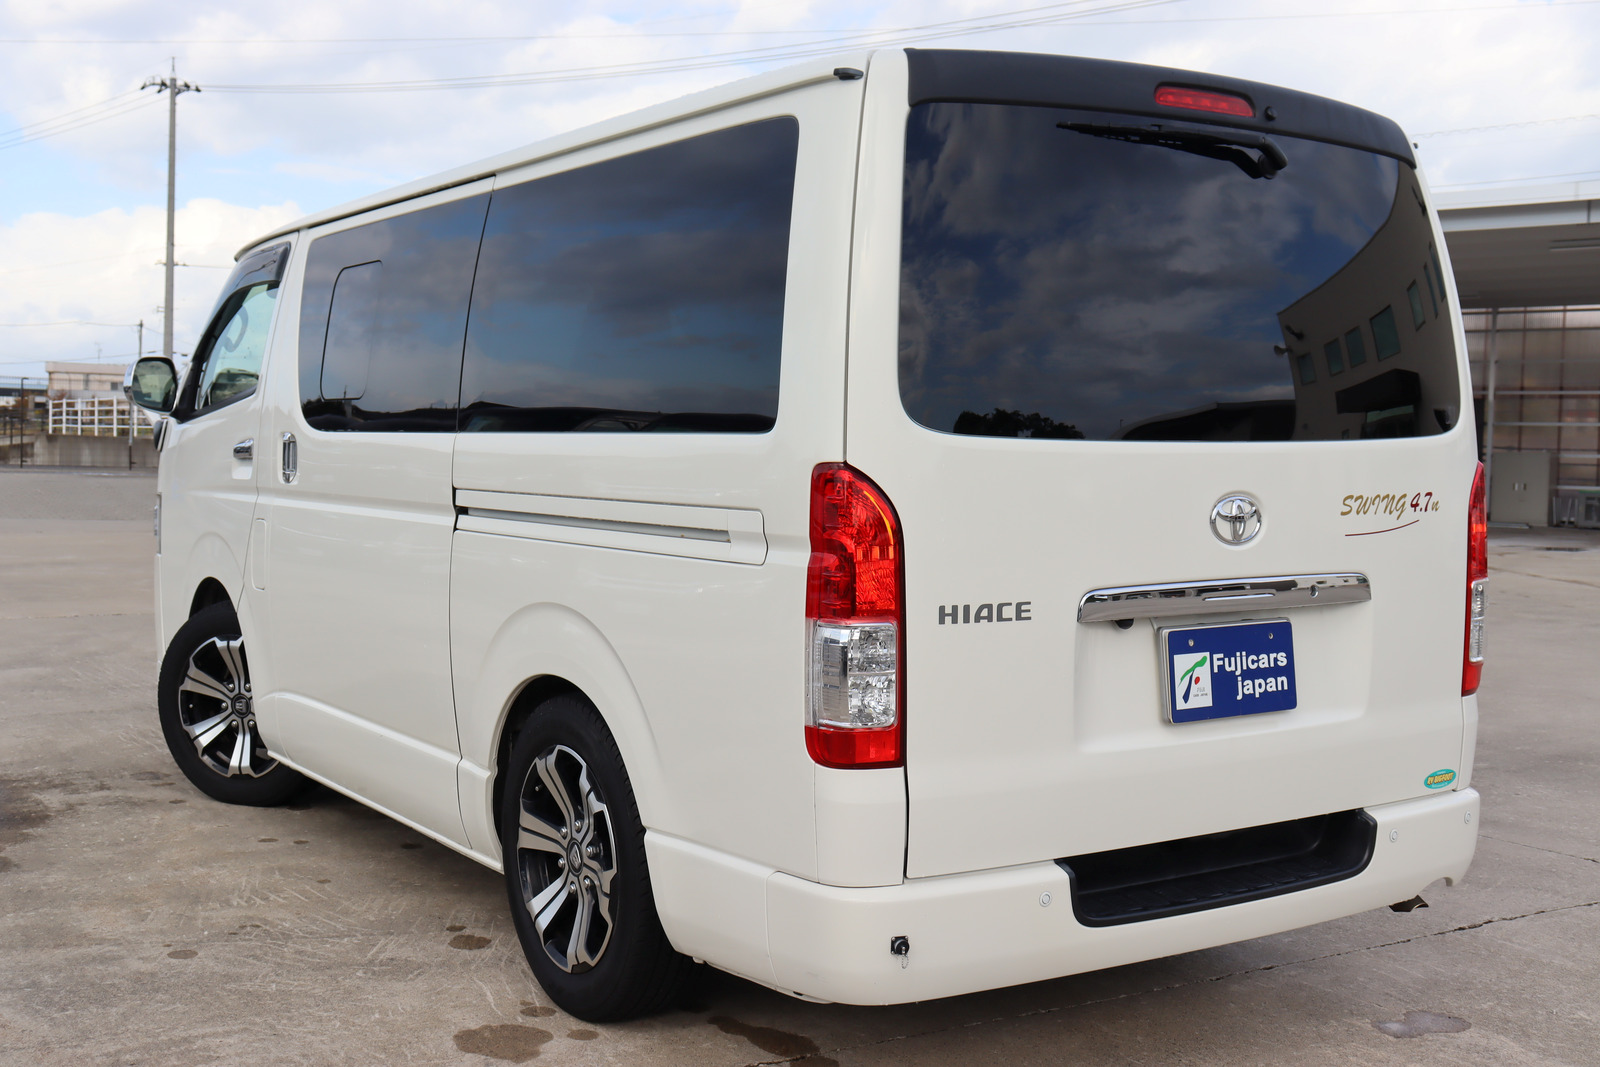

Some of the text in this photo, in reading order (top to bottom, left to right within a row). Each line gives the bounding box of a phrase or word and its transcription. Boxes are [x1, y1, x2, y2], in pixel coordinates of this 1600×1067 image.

[1340, 494, 1408, 521] SWING
[938, 601, 1032, 625] HIACE
[1212, 651, 1288, 676] Fujicars
[1236, 675, 1289, 700] japan
